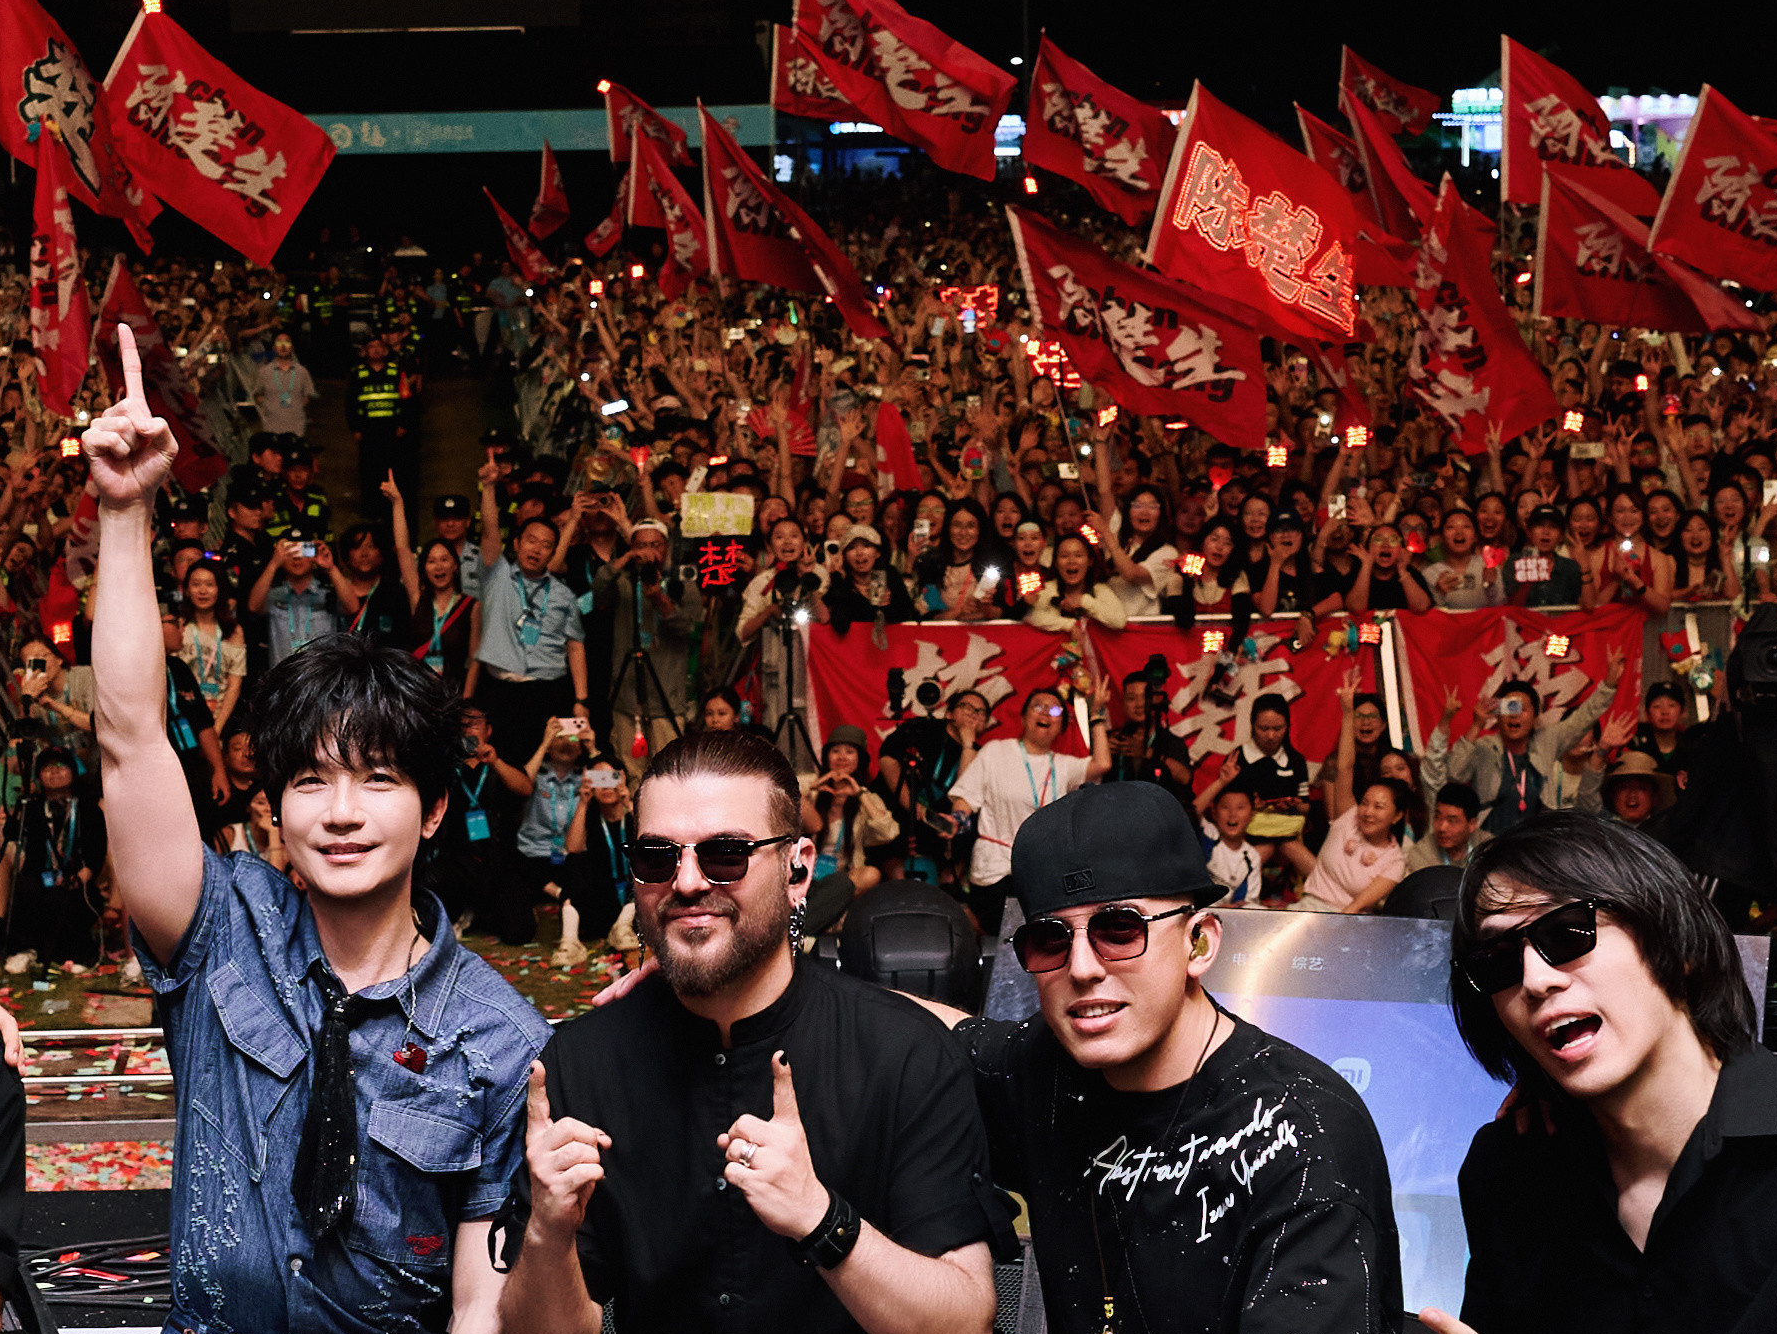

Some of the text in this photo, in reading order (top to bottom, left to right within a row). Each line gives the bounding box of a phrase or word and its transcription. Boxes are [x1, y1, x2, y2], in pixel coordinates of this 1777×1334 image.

[1173, 140, 1354, 337] 陈楚生
[698, 540, 743, 586] 楚
[1291, 956, 1324, 971] 综艺
